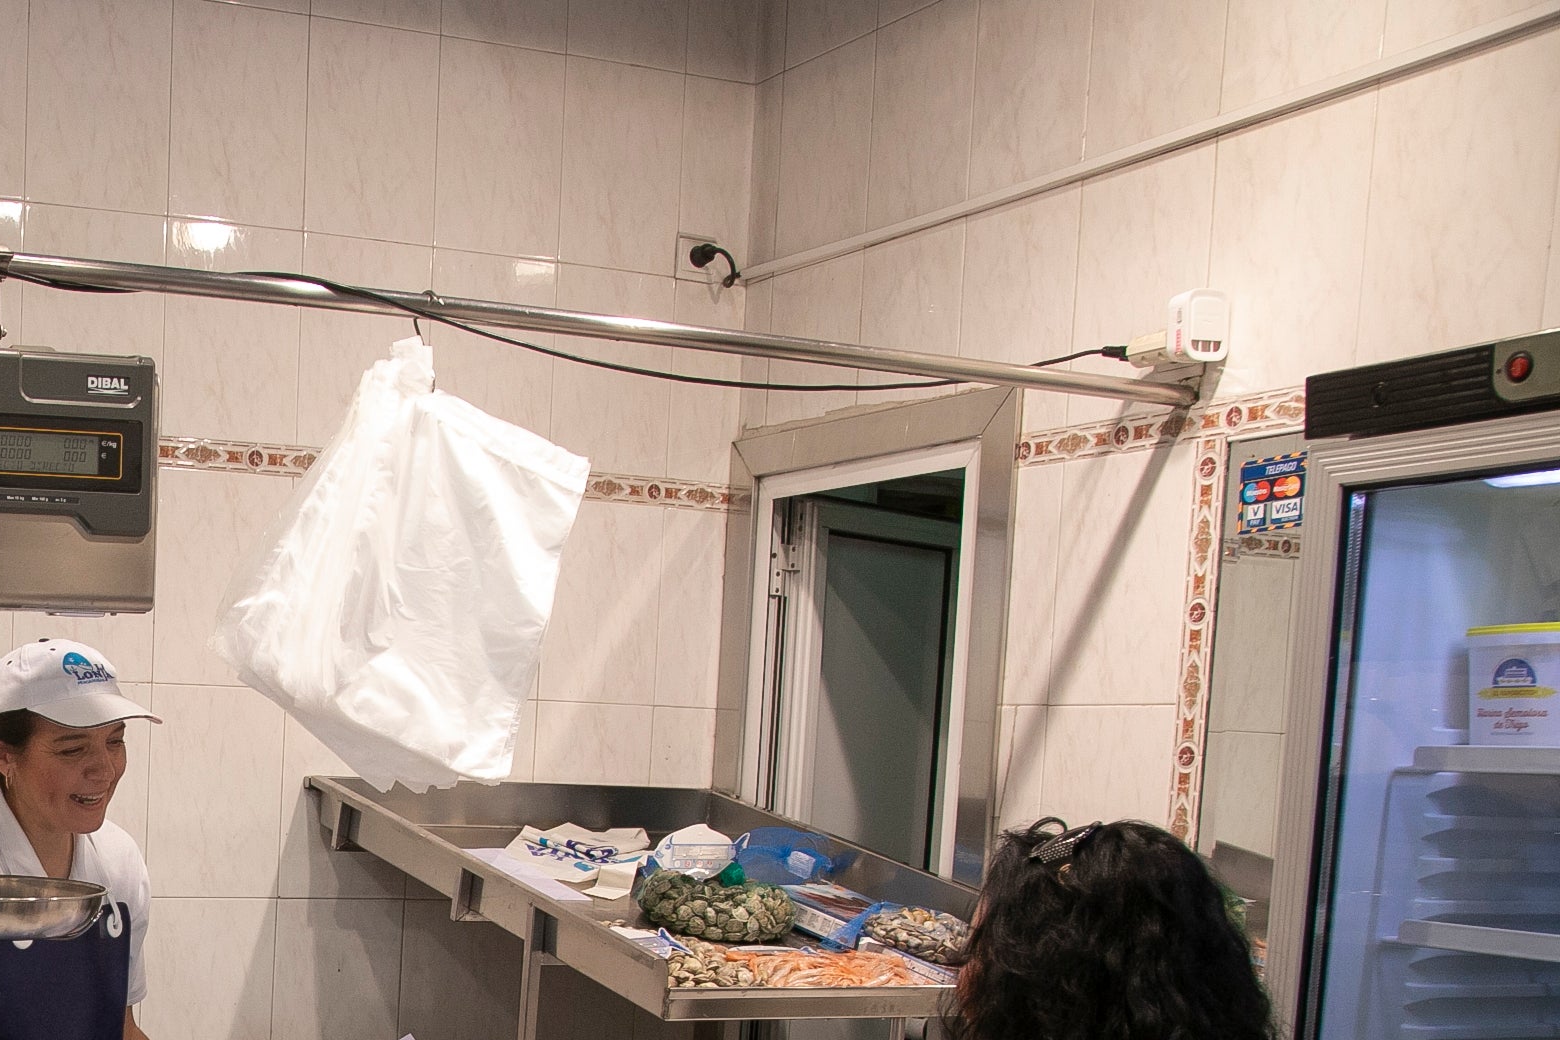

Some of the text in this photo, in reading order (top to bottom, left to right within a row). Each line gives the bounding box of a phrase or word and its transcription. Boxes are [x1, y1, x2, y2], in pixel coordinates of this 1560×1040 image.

[88, 376, 128, 390] DIBAL
[1265, 461, 1298, 476] TELEPAGO
[1274, 502, 1298, 515] VISA
